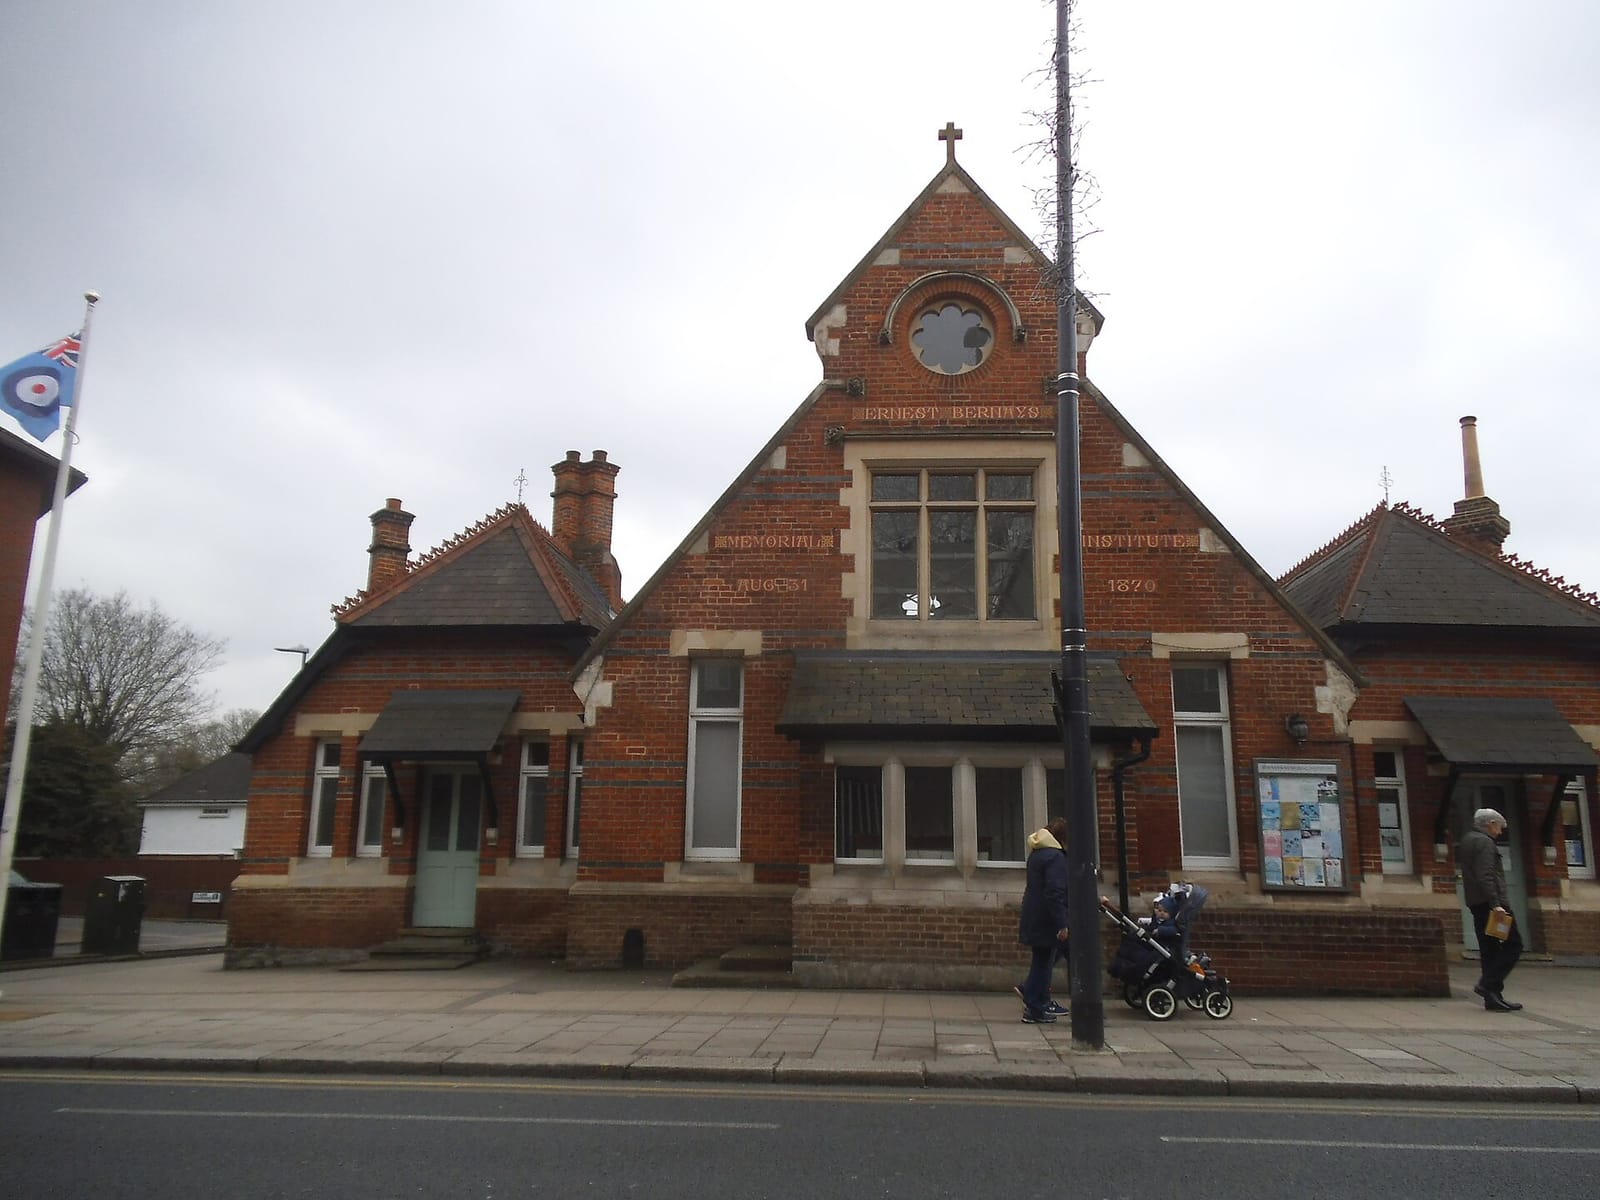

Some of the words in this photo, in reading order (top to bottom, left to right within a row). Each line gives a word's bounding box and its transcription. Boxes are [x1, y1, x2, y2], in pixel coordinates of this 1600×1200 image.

[865, 407, 940, 420] ERNEST
[952, 406, 1041, 419] BERNAYS
[727, 535, 821, 548] MEMORIAL
[1082, 534, 1186, 548] INSTITUTE
[737, 579, 775, 592] AUG
[788, 578, 808, 592] 31
[1108, 579, 1156, 593] 1870
